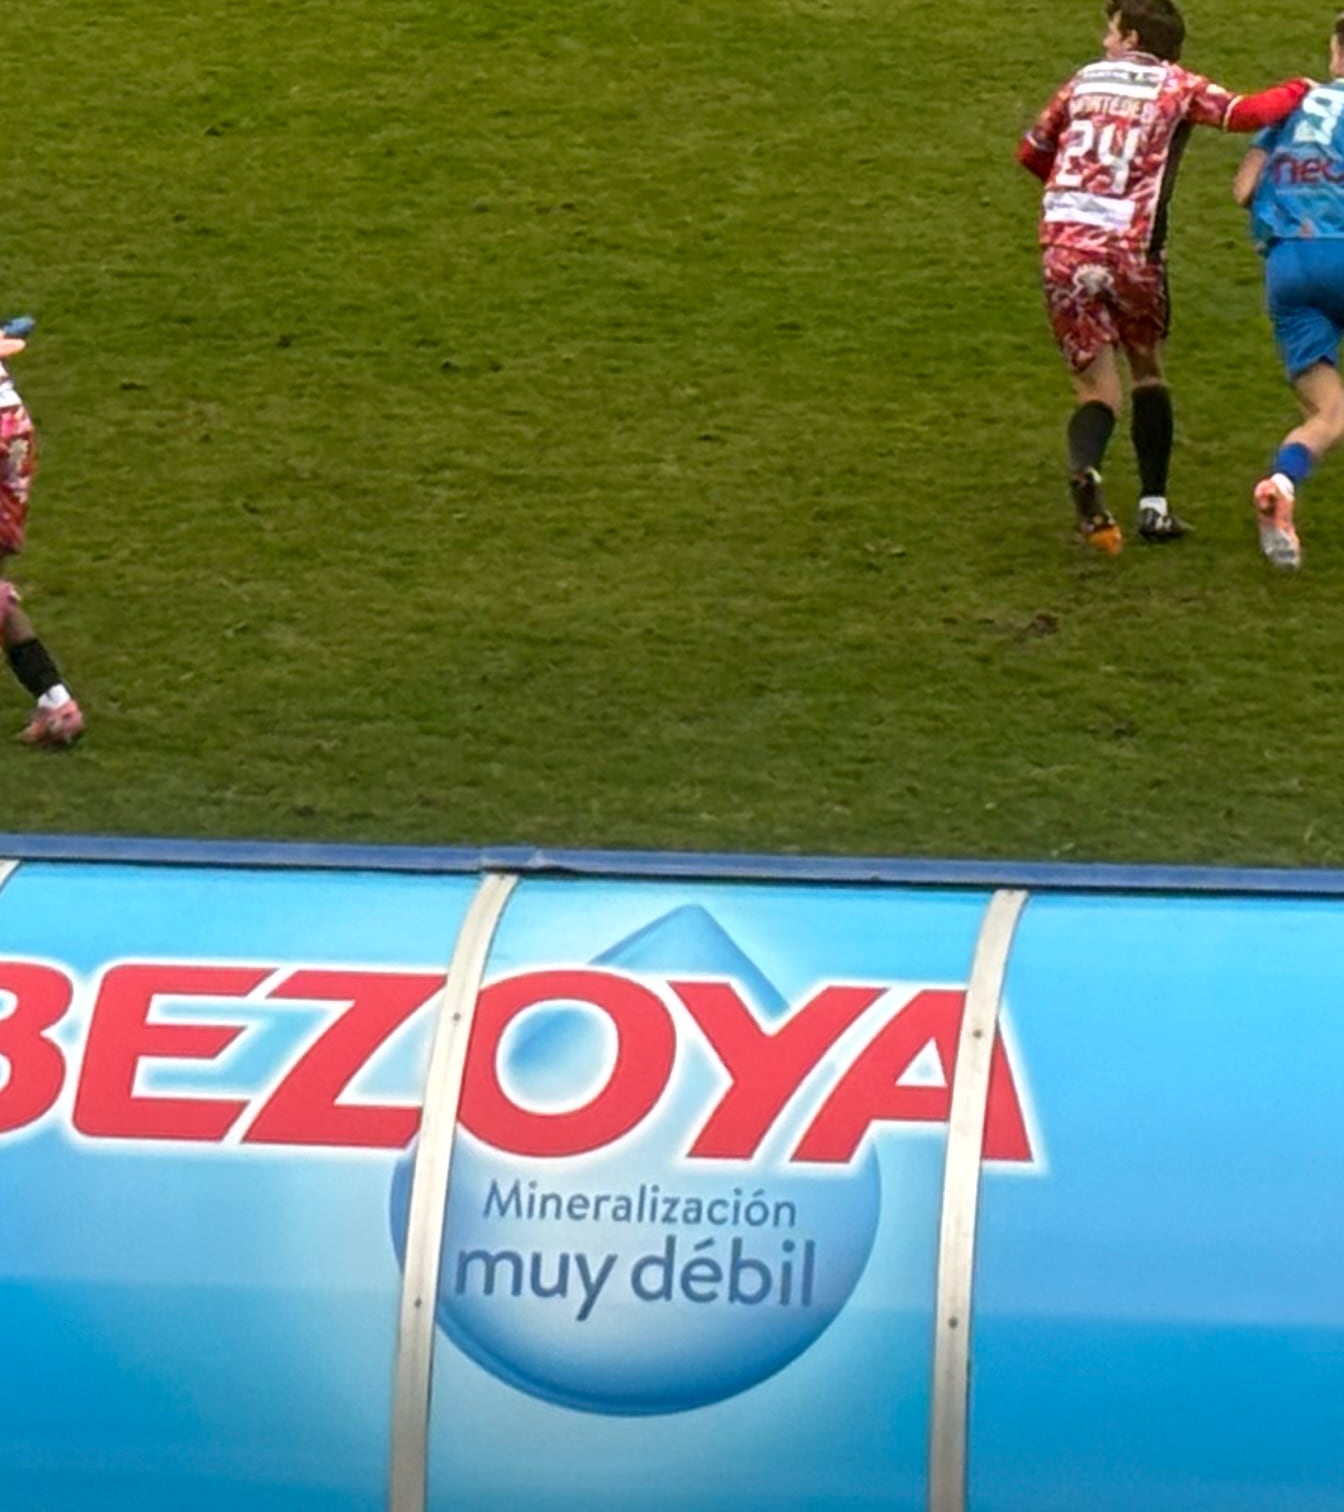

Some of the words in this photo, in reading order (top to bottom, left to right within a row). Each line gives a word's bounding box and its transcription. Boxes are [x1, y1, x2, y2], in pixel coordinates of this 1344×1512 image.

[1054, 119, 1142, 195] 24
[483, 1178, 797, 1228] Mineralización
[455, 1245, 618, 1321] muy
[630, 1234, 817, 1306] débil
